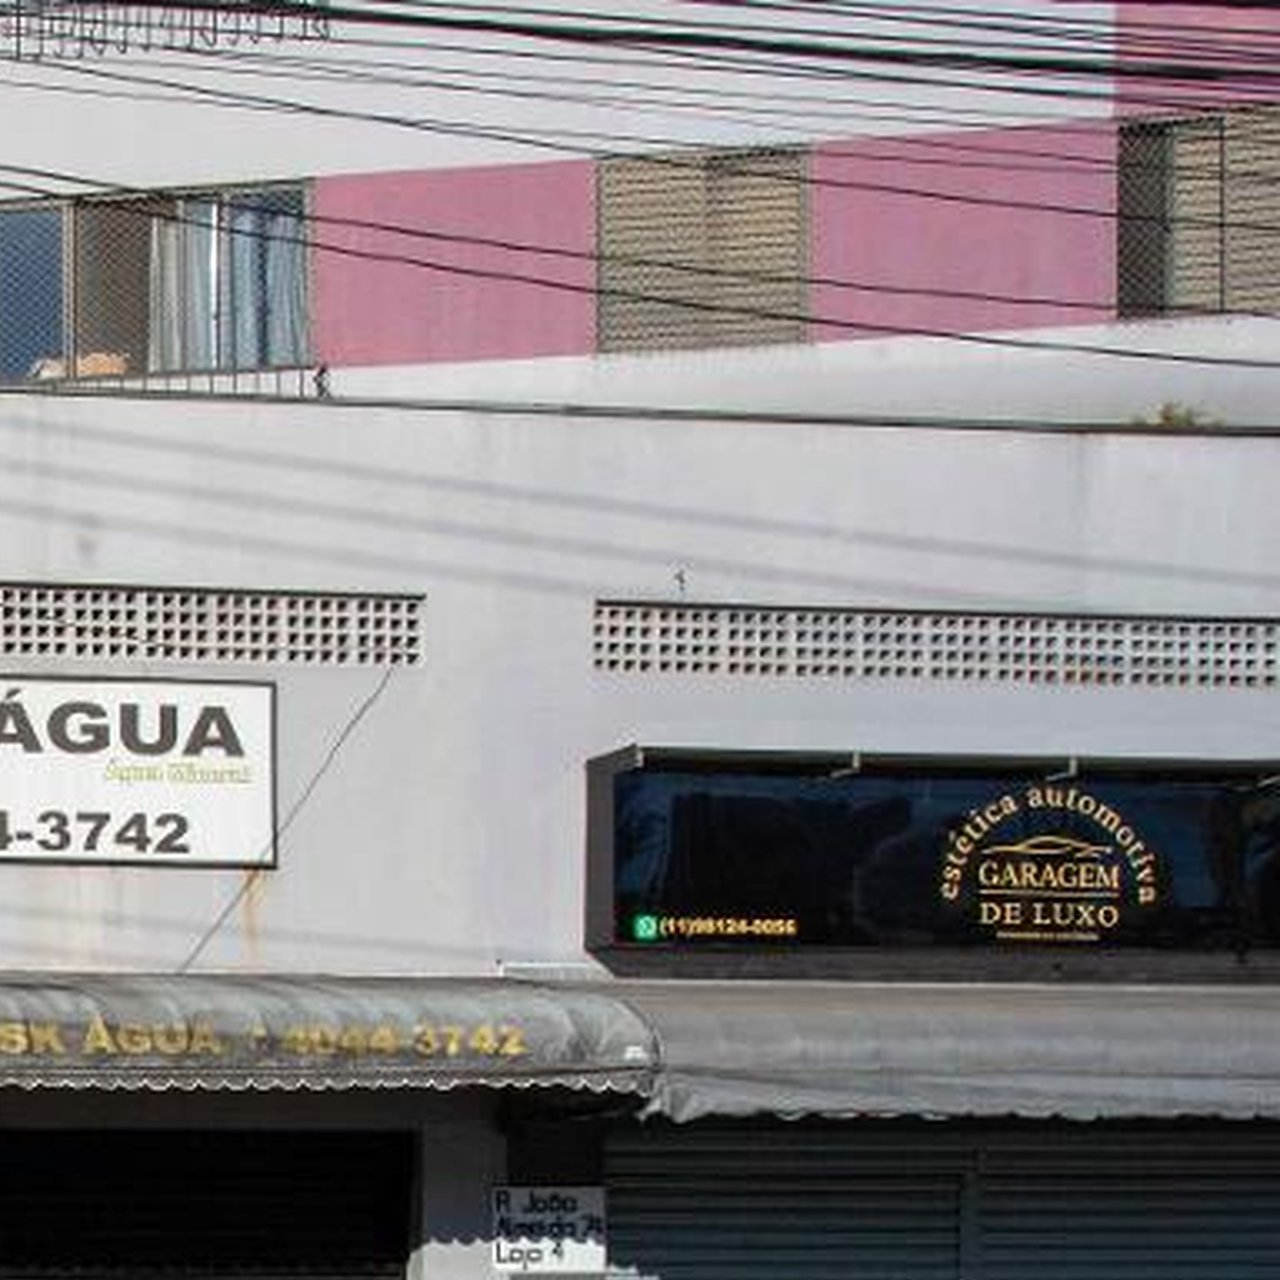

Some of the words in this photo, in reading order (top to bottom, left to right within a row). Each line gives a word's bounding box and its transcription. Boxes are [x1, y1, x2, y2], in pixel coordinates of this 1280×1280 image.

[978, 861, 1121, 889] GARAGEM
[979, 901, 1022, 925] DE
[1033, 902, 1121, 928] LUXO
[496, 1241, 543, 1271] Loja
